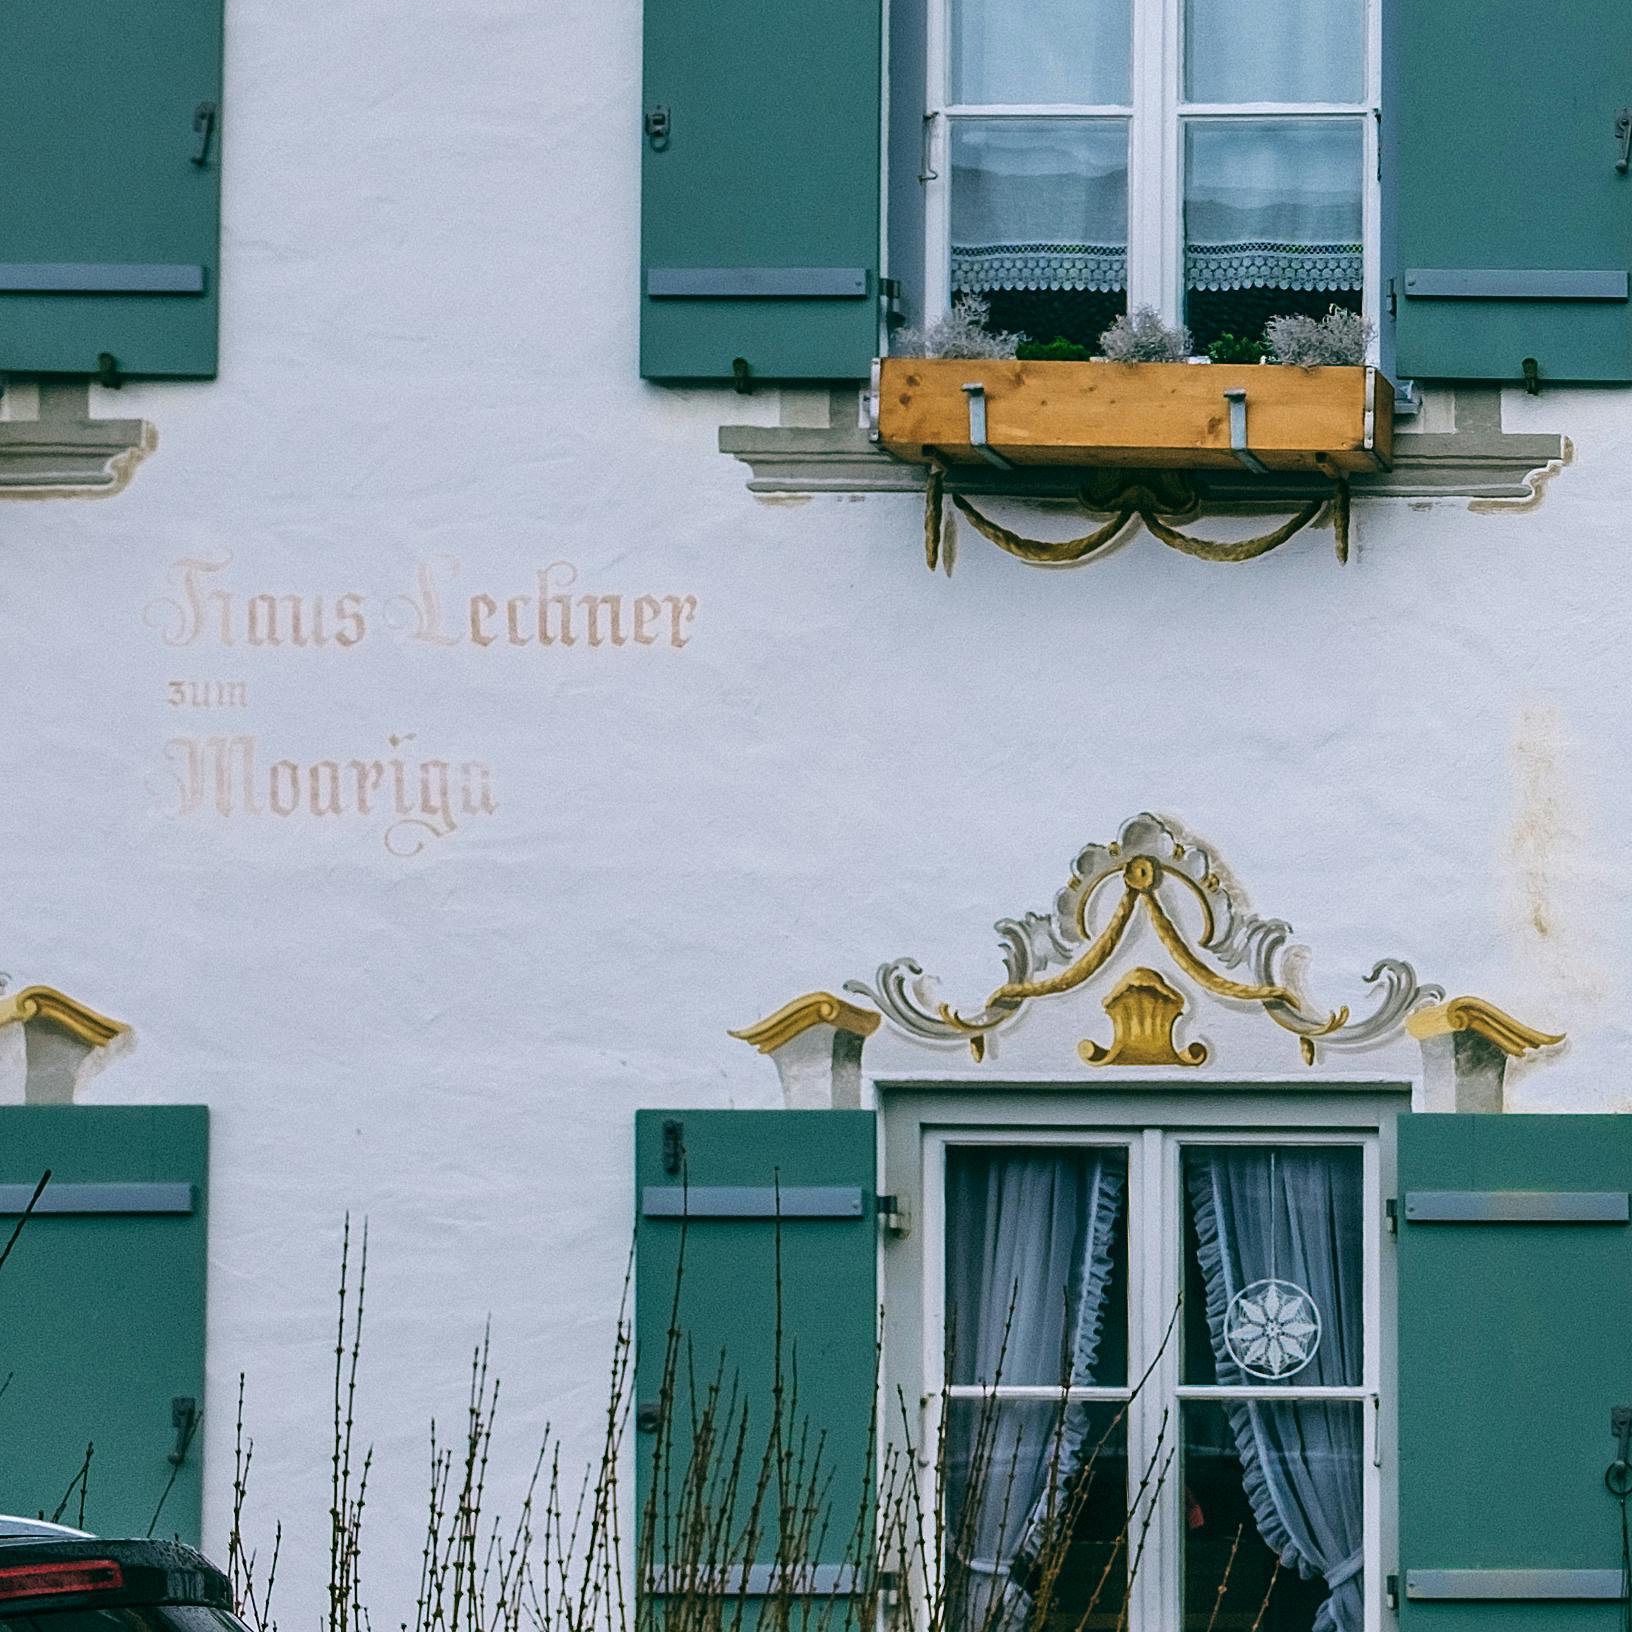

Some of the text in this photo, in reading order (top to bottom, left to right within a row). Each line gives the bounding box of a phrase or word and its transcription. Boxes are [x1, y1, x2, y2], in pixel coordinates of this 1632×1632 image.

[141, 547, 698, 650] Haus Lechner
[166, 678, 249, 710] zum
[157, 732, 498, 858] Moariga
